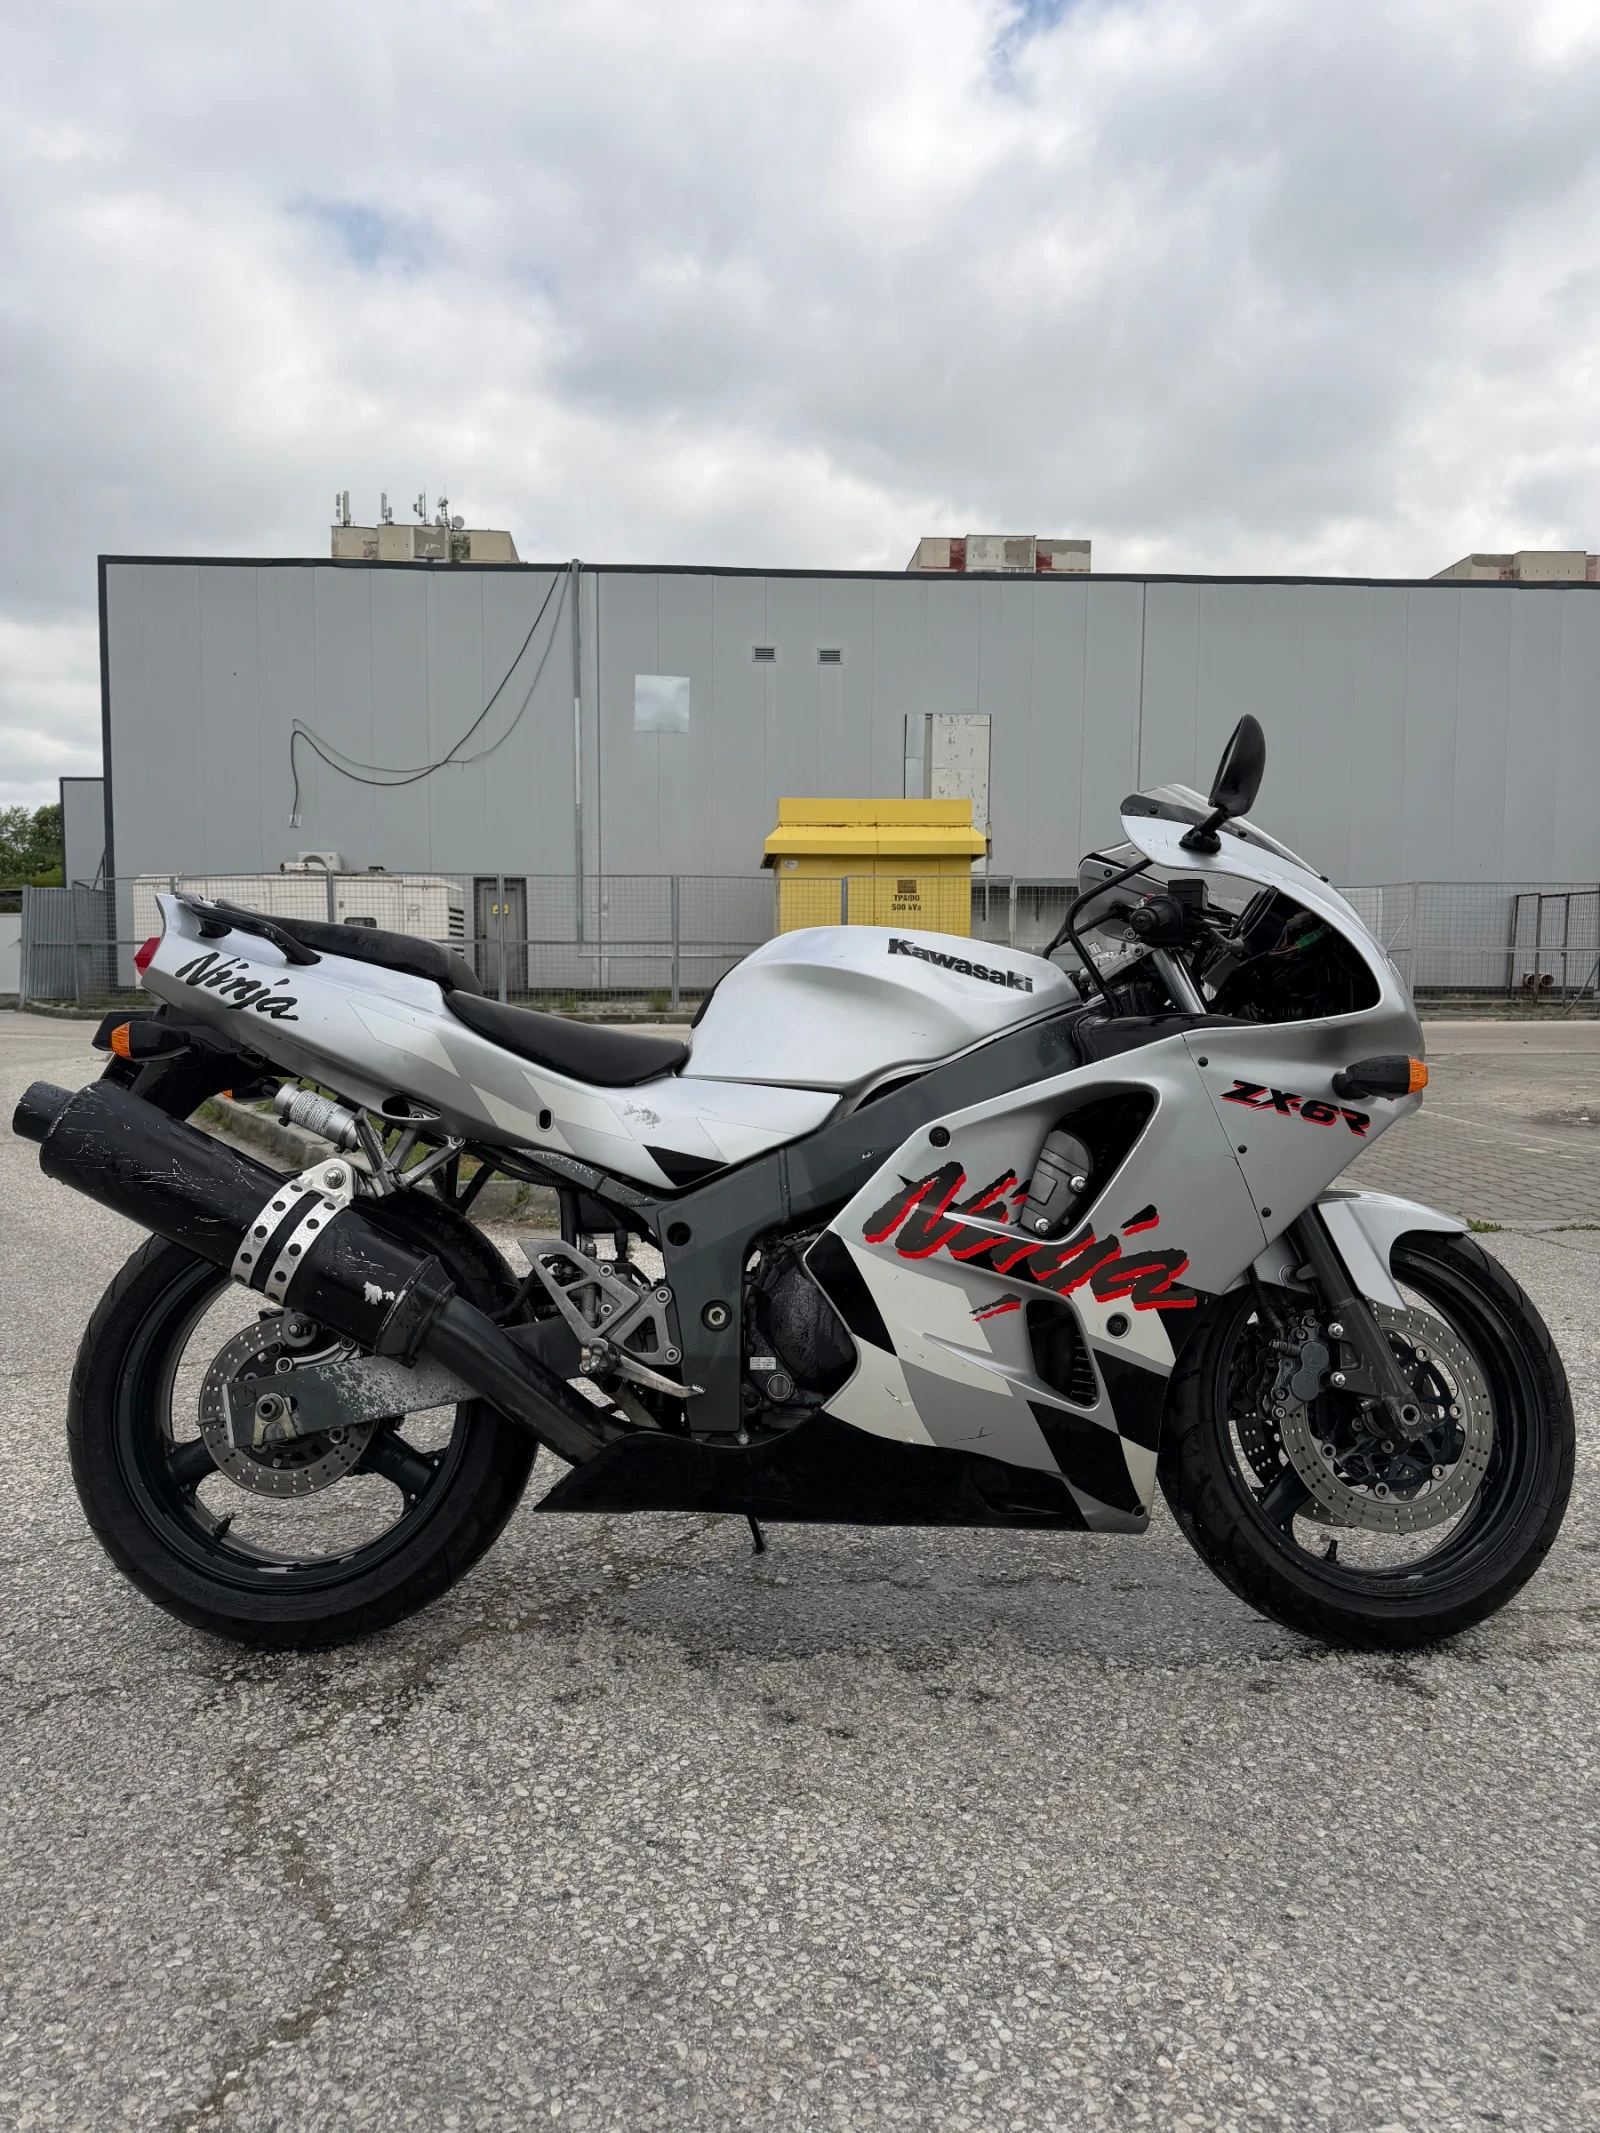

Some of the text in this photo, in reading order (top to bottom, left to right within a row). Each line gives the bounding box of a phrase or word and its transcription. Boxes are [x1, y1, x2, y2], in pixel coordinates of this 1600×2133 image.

[892, 903, 906, 911] 500
[175, 952, 299, 1021] Ninja
[888, 938, 1033, 993] Kawasaki
[1219, 1079, 1371, 1138] ZX-6R
[862, 1161, 1197, 1321] Ninja
